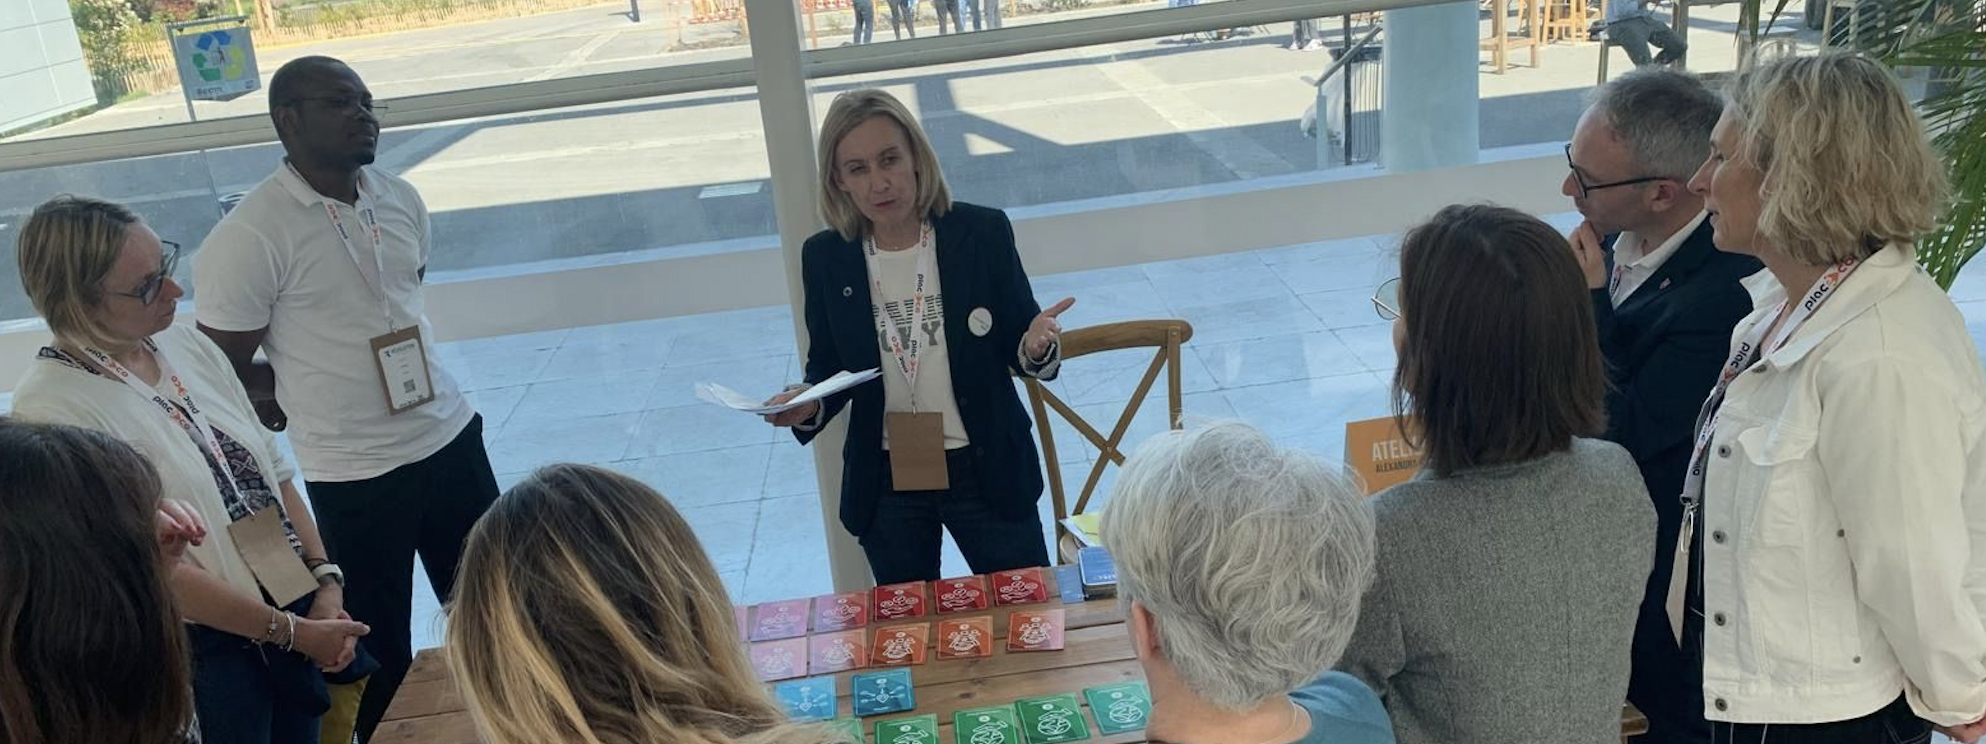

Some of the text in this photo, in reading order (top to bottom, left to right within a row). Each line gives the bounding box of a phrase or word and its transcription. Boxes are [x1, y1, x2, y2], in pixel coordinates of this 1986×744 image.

[1804, 283, 1829, 311] plac
[1731, 342, 1751, 368] plac
[152, 395, 174, 413] plac
